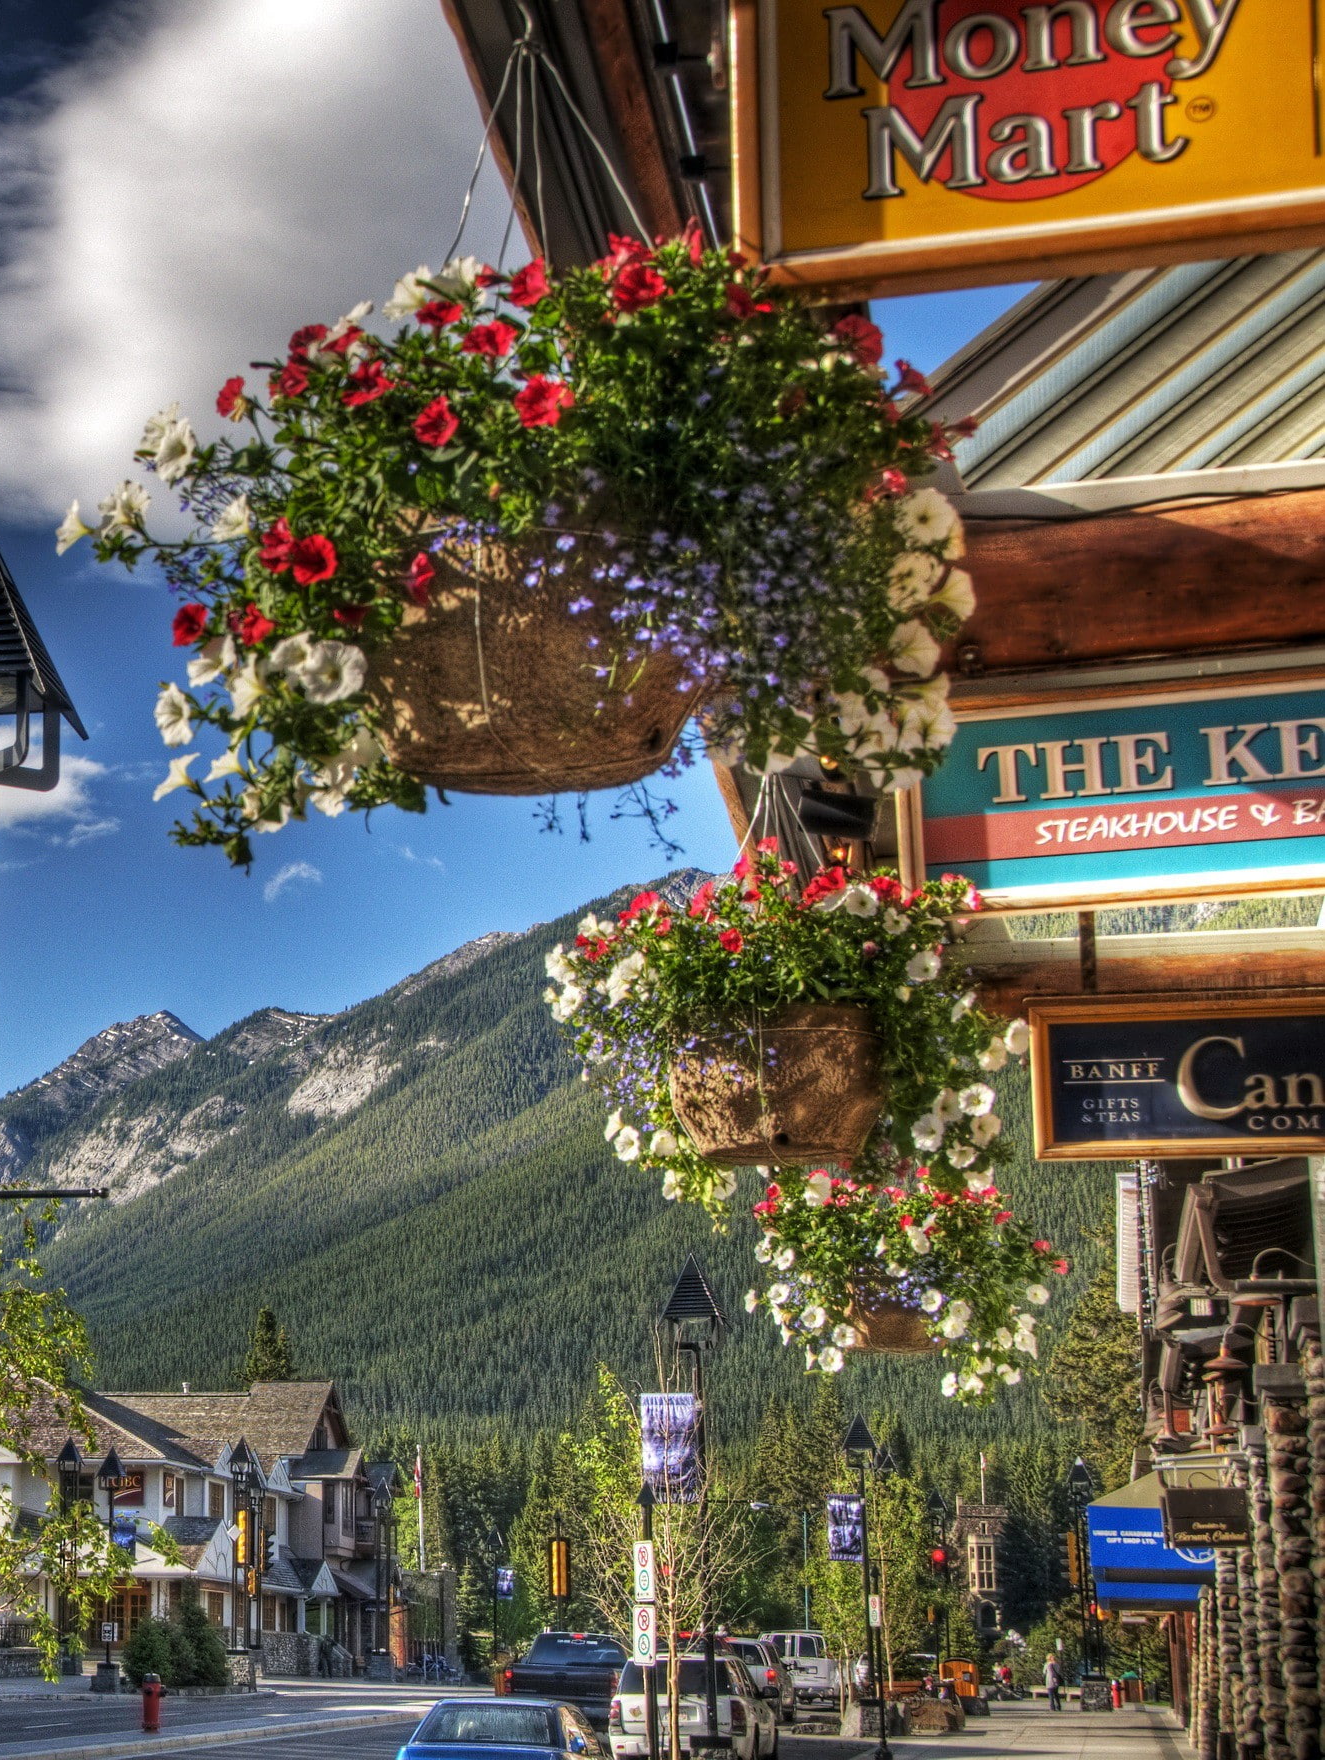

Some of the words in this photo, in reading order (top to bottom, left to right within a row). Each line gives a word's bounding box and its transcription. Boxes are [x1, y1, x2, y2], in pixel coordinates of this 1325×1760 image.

[822, 0, 1240, 98] Money
[861, 82, 1190, 200] Mart
[977, 731, 1173, 803] THE
[1198, 717, 1325, 786] KE
[1035, 805, 1239, 845] STEAKHOUSE
[1250, 803, 1282, 827] &
[1070, 1062, 1160, 1079] BANFF
[1177, 1036, 1325, 1120] Can
[1081, 1113, 1093, 1123] &
[1096, 1111, 1141, 1123] TEAS
[1082, 1098, 1140, 1110] GIFTS
[1247, 1115, 1320, 1130] COM
[112, 1475, 141, 1488] CIBC
